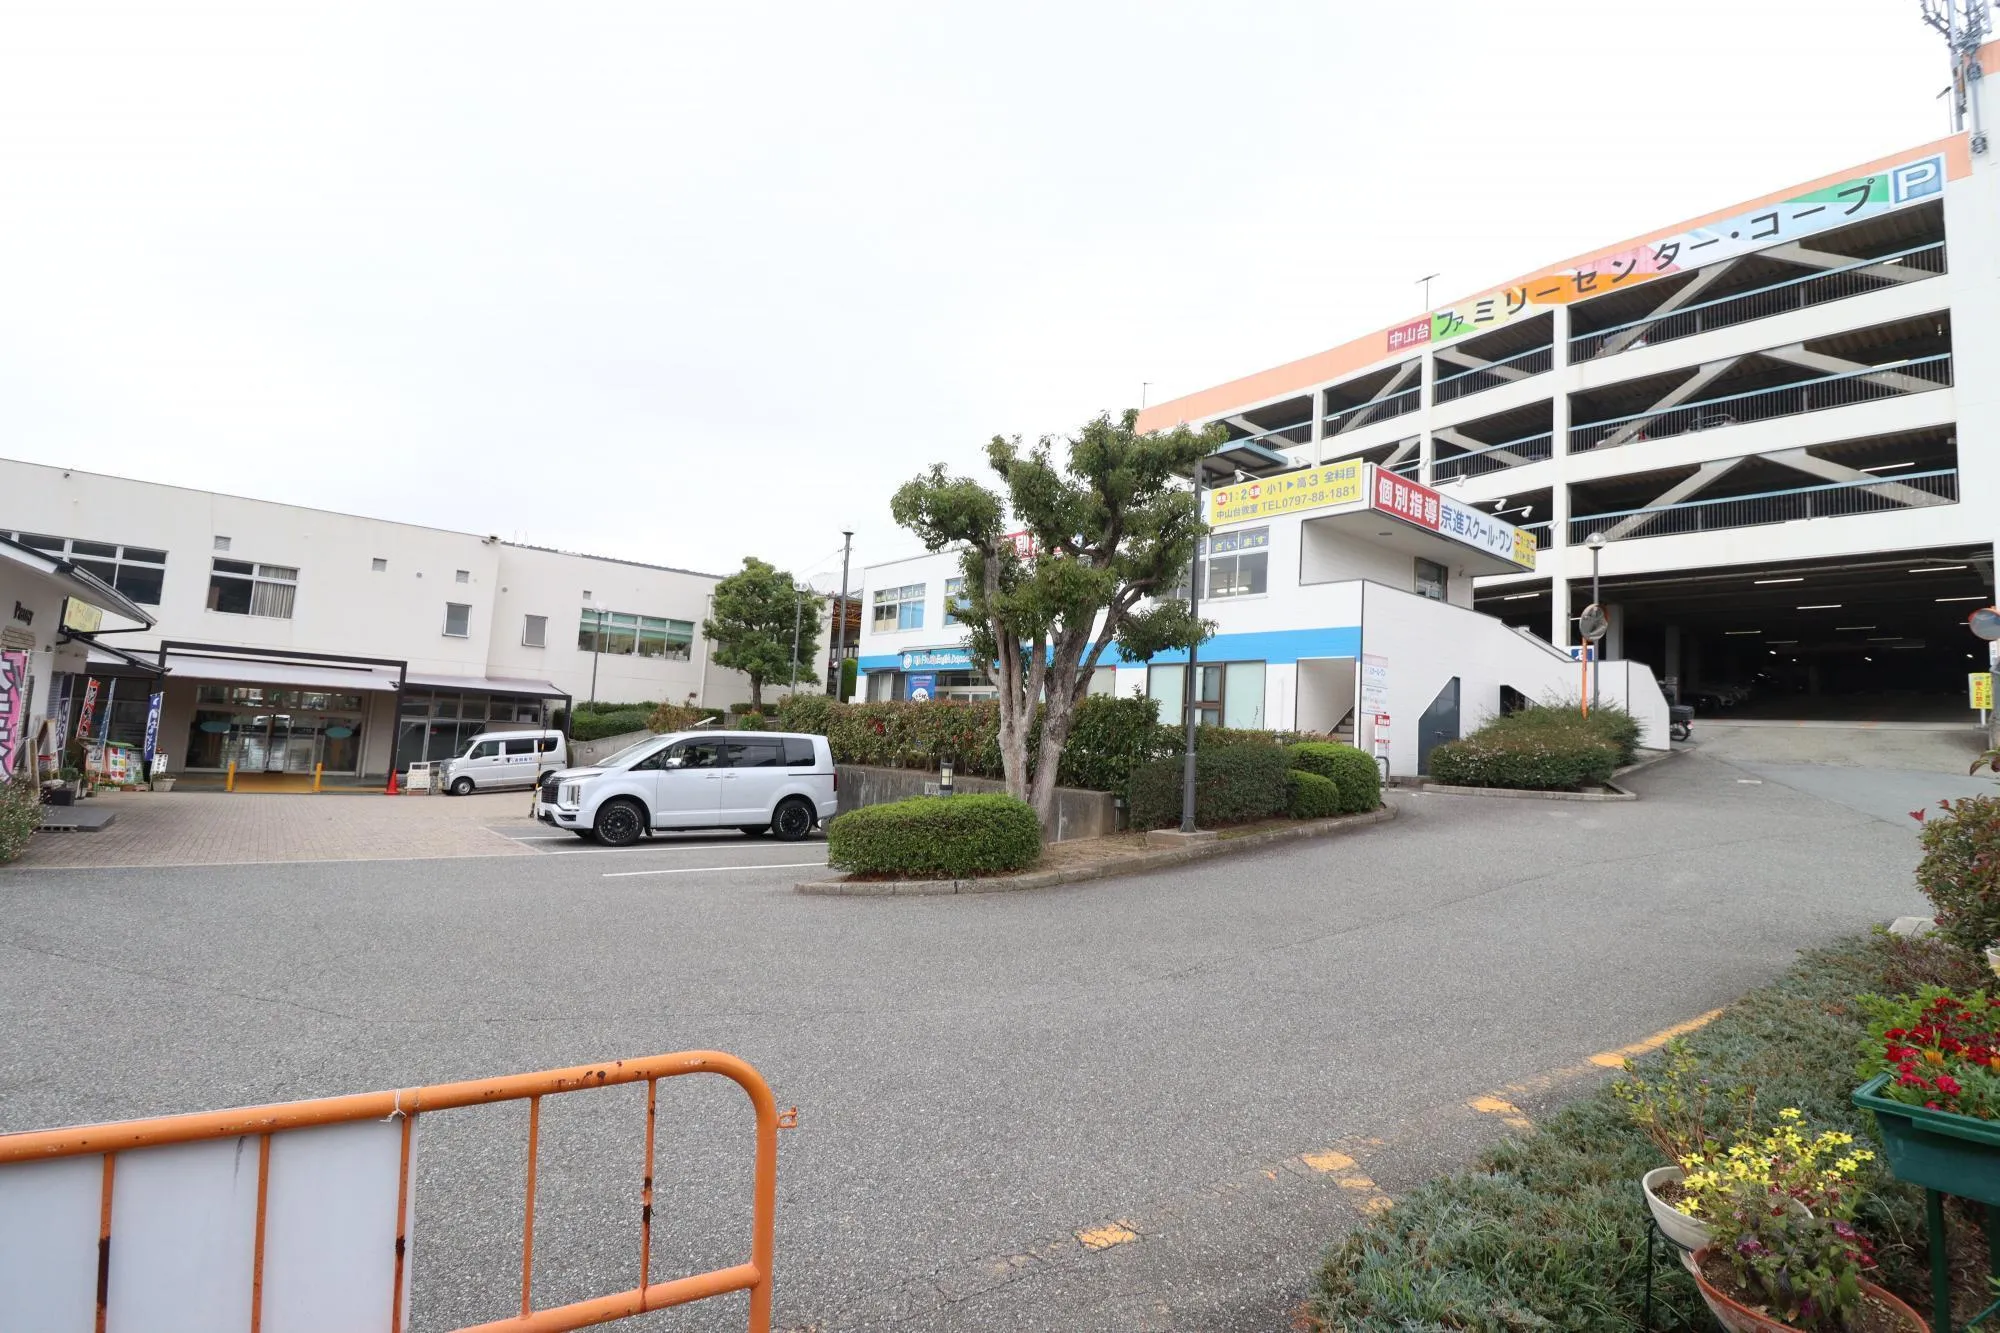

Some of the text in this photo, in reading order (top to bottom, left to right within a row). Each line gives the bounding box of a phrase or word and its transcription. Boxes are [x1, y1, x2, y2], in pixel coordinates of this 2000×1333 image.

[1389, 178, 1876, 349] 中山台 ファミリーセンター・コープ
[1324, 467, 1356, 483] 全科目
[1216, 504, 1258, 521] 中山台教室
[1379, 476, 1438, 526] 個別指導
[1440, 504, 1513, 553] 京進スクール・ワン
